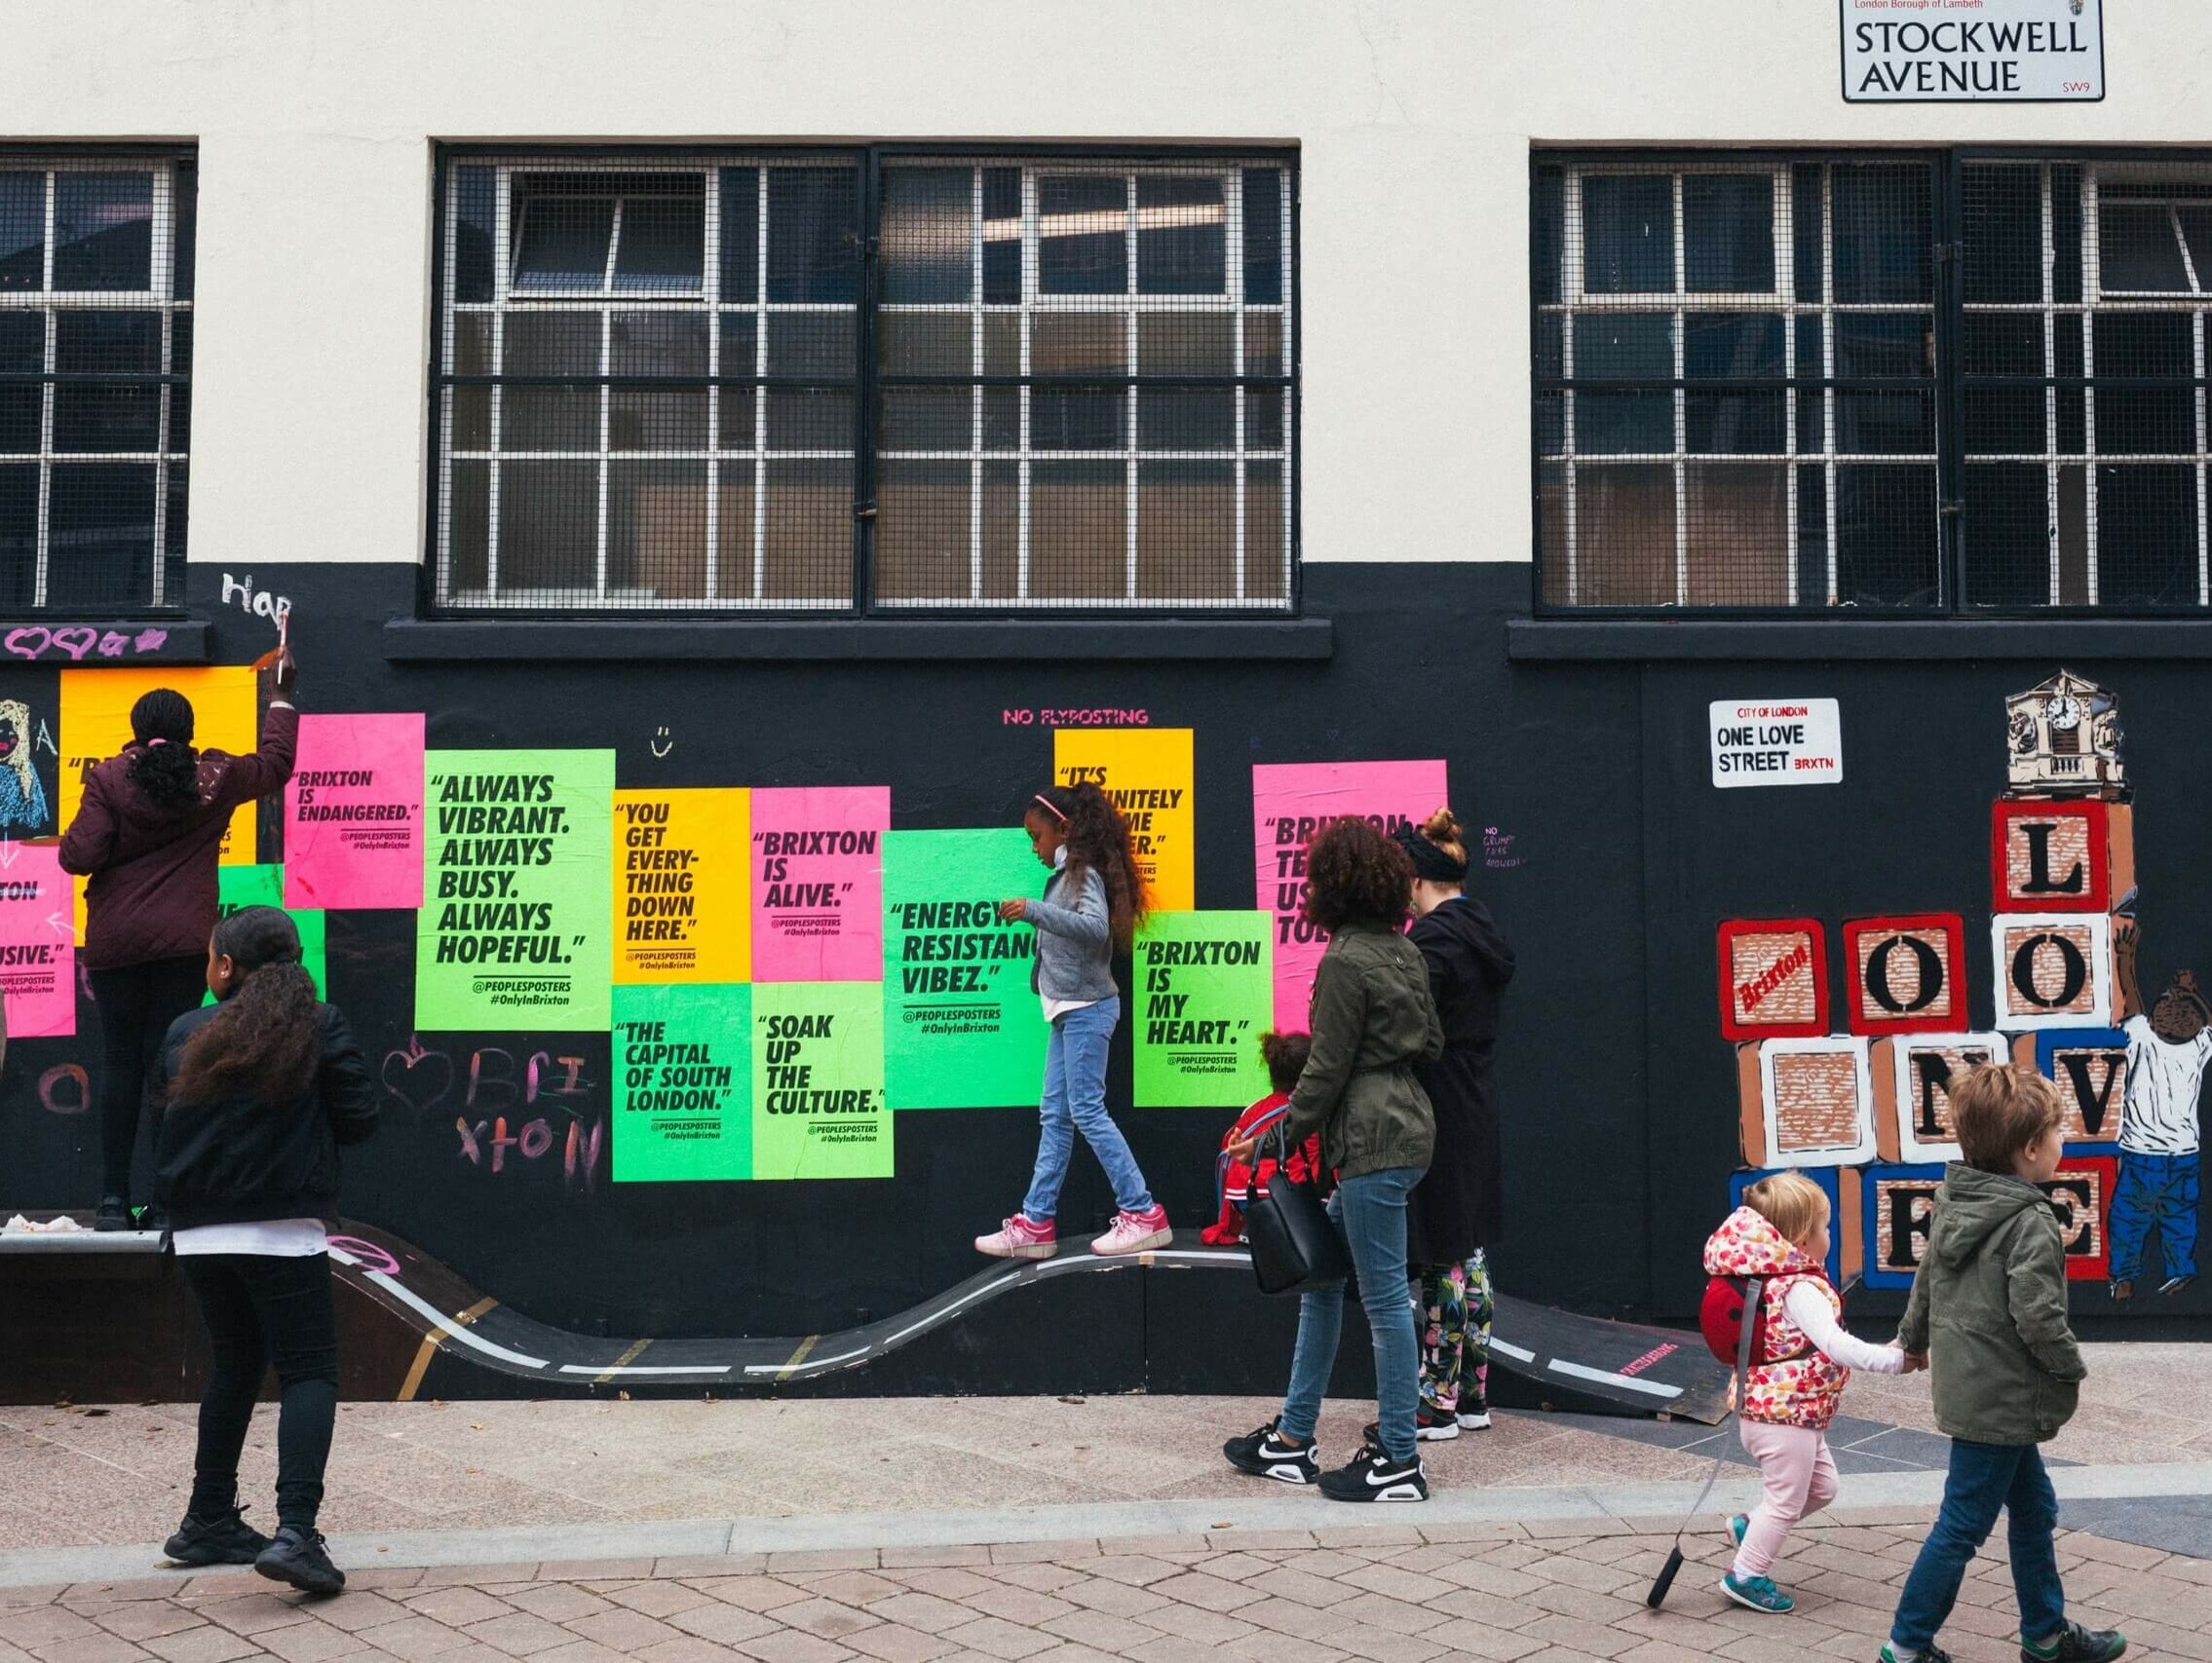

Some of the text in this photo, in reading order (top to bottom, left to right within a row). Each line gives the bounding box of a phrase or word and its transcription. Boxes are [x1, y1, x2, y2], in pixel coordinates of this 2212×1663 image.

[1890, 0, 1928, 10] Borough
[1856, 22, 2087, 53] STOCKWELL
[1859, 61, 2020, 92] AVENUE
[2062, 82, 2091, 93] SW9
[1003, 709, 1149, 725] NO FLYPOSTING
[1737, 706, 1808, 718] CITY OF LONDON
[1717, 725, 1805, 746] ONE LOVE
[1719, 751, 1789, 772] STREET
[1795, 758, 1834, 770] BRXTN
[292, 770, 373, 787] “BRIXTON
[432, 775, 553, 802] “ALWAYS
[298, 789, 314, 804] IS
[298, 805, 418, 821] ENDANGERED.”
[439, 807, 569, 834] VIBRANT.
[616, 804, 669, 823] “YOU
[340, 832, 410, 841] @PEOPLESPOSTERS
[627, 827, 667, 847] GET
[1485, 827, 1498, 836] NO
[353, 842, 410, 850] #OnlyInBrixton
[439, 838, 553, 865] ALWAYS
[754, 831, 876, 855] “BRIXTON
[627, 850, 699, 870] EVERY-
[764, 858, 787, 882] IS
[439, 871, 517, 898] BUSY.
[627, 873, 693, 893] THING
[764, 884, 852, 907] ALIVE.”
[438, 903, 552, 930] ALWAYS
[627, 896, 694, 917] DOWN
[627, 920, 697, 940] HERE.”
[771, 919, 841, 928] @PEOPLESPOSTERS
[784, 927, 840, 937] #OnlyInBrixton
[437, 936, 585, 964] HOPEFUL.”
[626, 952, 697, 962] @PEOPLESPOSTERS
[1137, 941, 1260, 964] “BRIXTON
[638, 962, 696, 970] #OnlyInBrixton
[474, 982, 571, 993] @PEOPLESPOSTERS
[903, 965, 1000, 993] VIBEZ.”
[1147, 968, 1170, 992] IS
[1738, 944, 1811, 1013] Brixton
[491, 994, 569, 1006] #OnlyInBrixton
[1147, 995, 1189, 1018] MY
[902, 1009, 1001, 1023] @PEOPLESPOSTERS
[616, 1022, 665, 1042] “THE
[759, 1015, 833, 1039] “SOAK
[921, 1023, 1000, 1035] #OnlyInBrixton
[1147, 1021, 1248, 1044] HEART.”
[626, 1044, 710, 1065] CAPITAL
[767, 1040, 801, 1064] UP
[1166, 1056, 1238, 1065] @PEOPLESPOSTERS
[627, 1067, 731, 1088] OF SOUTH
[767, 1066, 811, 1088] THE
[1179, 1065, 1237, 1075] #OnlyInBrixton
[627, 1089, 731, 1111] LONDON.”
[650, 1120, 722, 1131] @PEOPLESPOSTERS
[663, 1130, 721, 1141] #OnlyInBrixton
[808, 1123, 878, 1136] @PEOPLESPOSTERS
[820, 1133, 878, 1144] #OnlyInBrixton
